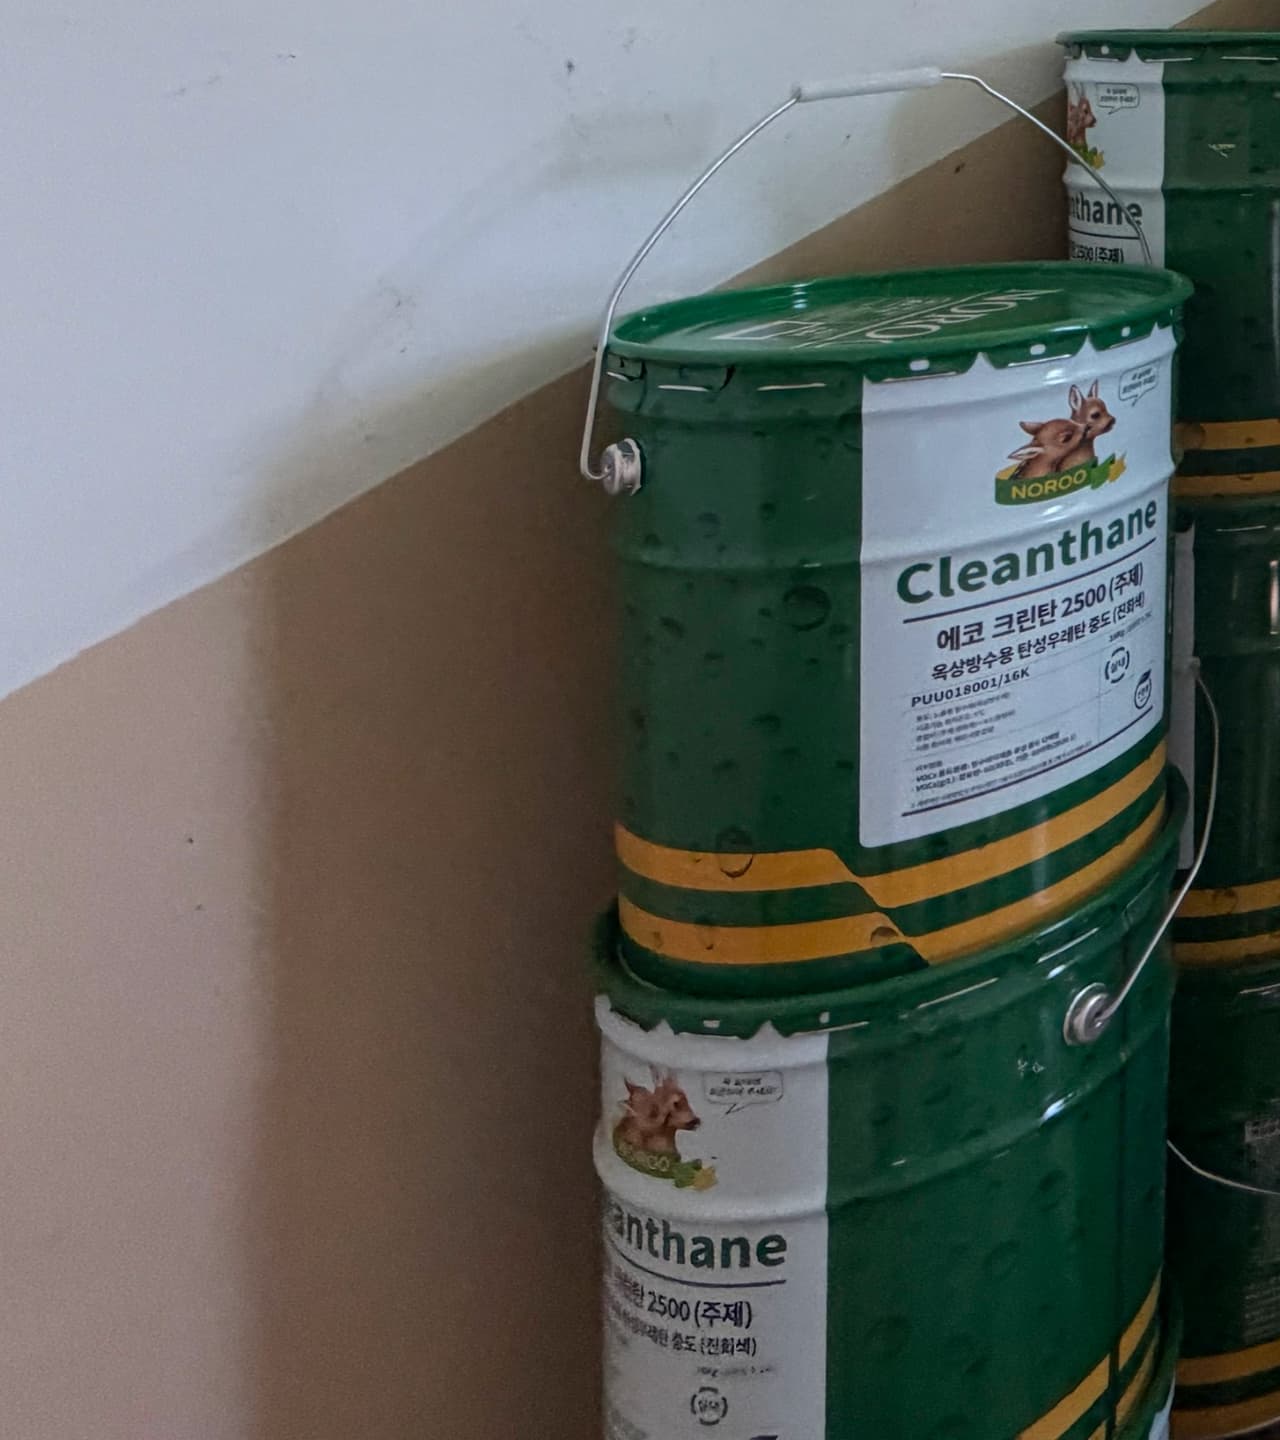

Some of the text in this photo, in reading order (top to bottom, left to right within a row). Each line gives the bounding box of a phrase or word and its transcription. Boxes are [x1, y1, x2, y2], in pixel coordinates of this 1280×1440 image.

[1011, 469, 1088, 500] NOROO
[896, 499, 1158, 604] Cleanthane
[936, 562, 1144, 652] 에코 크린탄 2500 (주제)
[931, 646, 1016, 681] 옥상방수용
[1017, 622, 1086, 661] 탄성우레탄
[1088, 610, 1112, 635] 중도
[647, 1291, 691, 1322] 2500
[694, 1300, 753, 1330] (주제)
